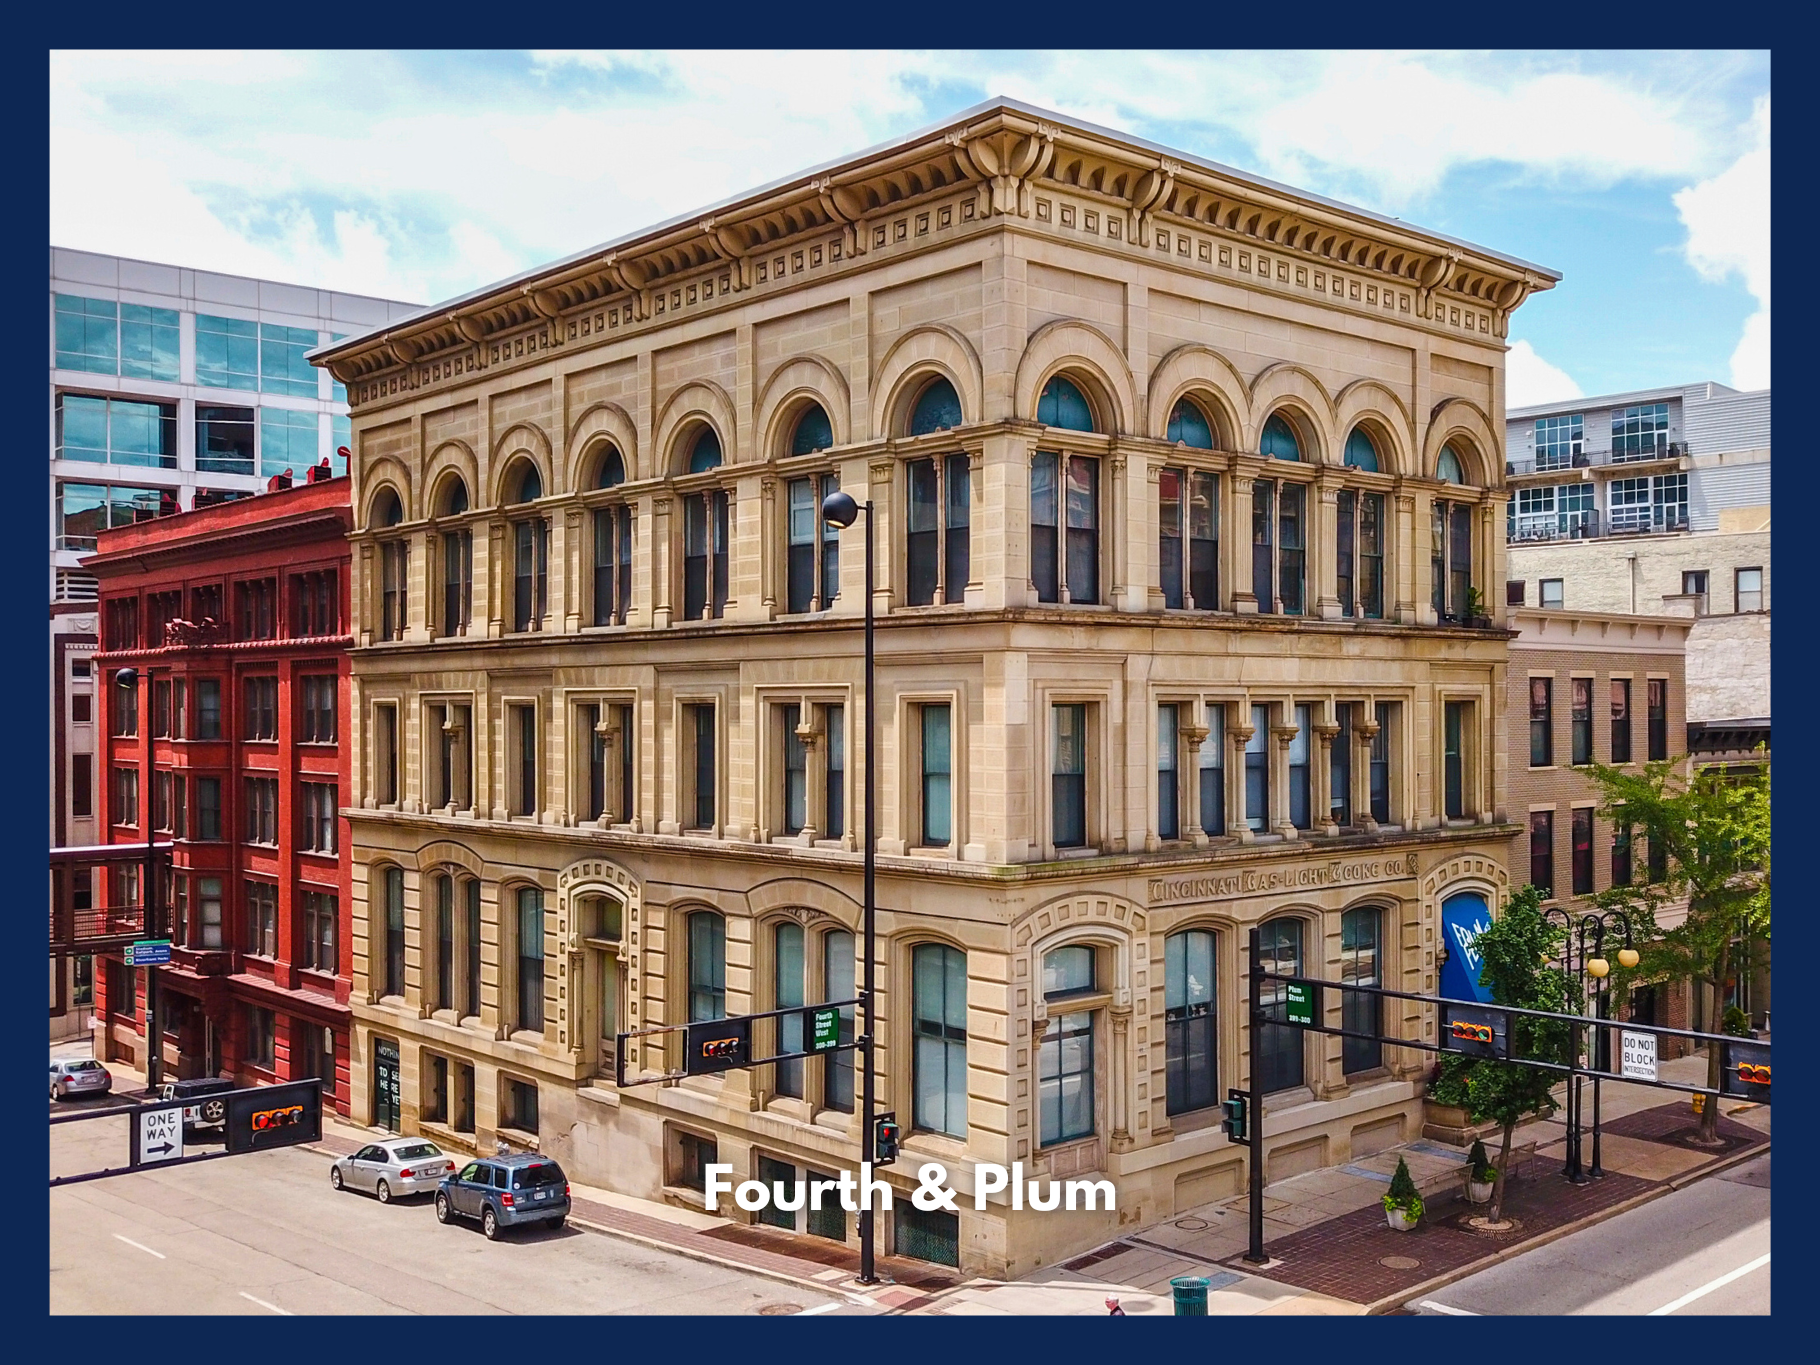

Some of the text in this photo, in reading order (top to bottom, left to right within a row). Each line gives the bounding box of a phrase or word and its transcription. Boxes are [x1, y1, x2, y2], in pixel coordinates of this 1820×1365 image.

[1151, 876, 1241, 902] CINCINNATI
[1343, 862, 1379, 880] COKE
[1288, 985, 1302, 994] Plum
[1288, 994, 1305, 1003] Street
[815, 1012, 833, 1021] Fourth
[815, 1020, 831, 1029] Street
[815, 1029, 829, 1037] West
[1624, 1037, 1654, 1051] DO NOT
[1624, 1052, 1655, 1066] BLOCK
[379, 1066, 388, 1078] TO
[1624, 1065, 1655, 1076] INTERSECTION
[147, 1112, 176, 1127] ONE
[146, 1125, 176, 1141] WAY
